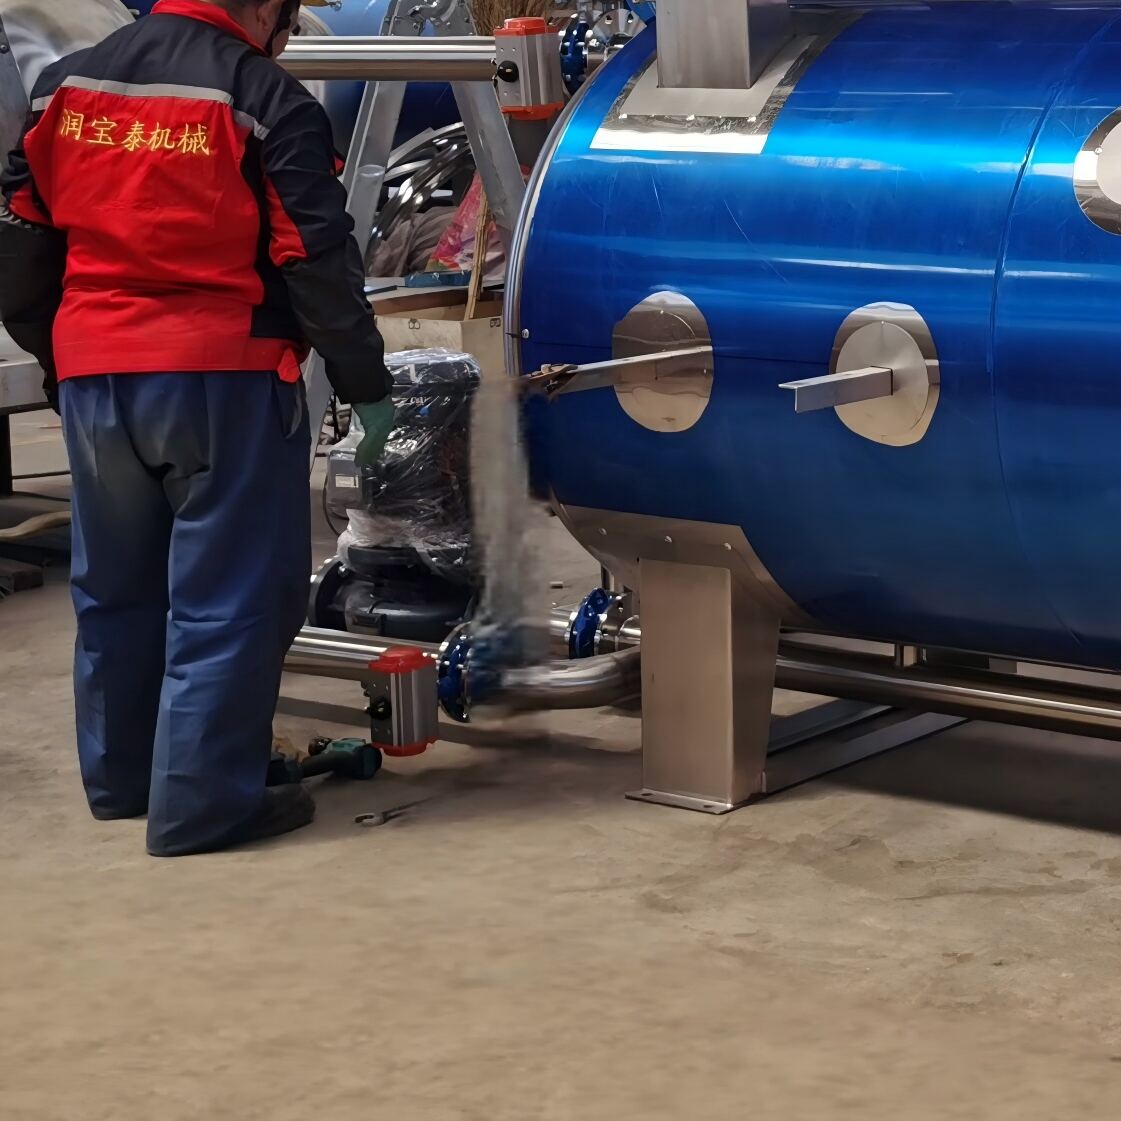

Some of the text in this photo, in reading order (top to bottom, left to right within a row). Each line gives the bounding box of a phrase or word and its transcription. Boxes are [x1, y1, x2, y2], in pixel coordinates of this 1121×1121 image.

[60, 108, 211, 156] 润宝泰机械
